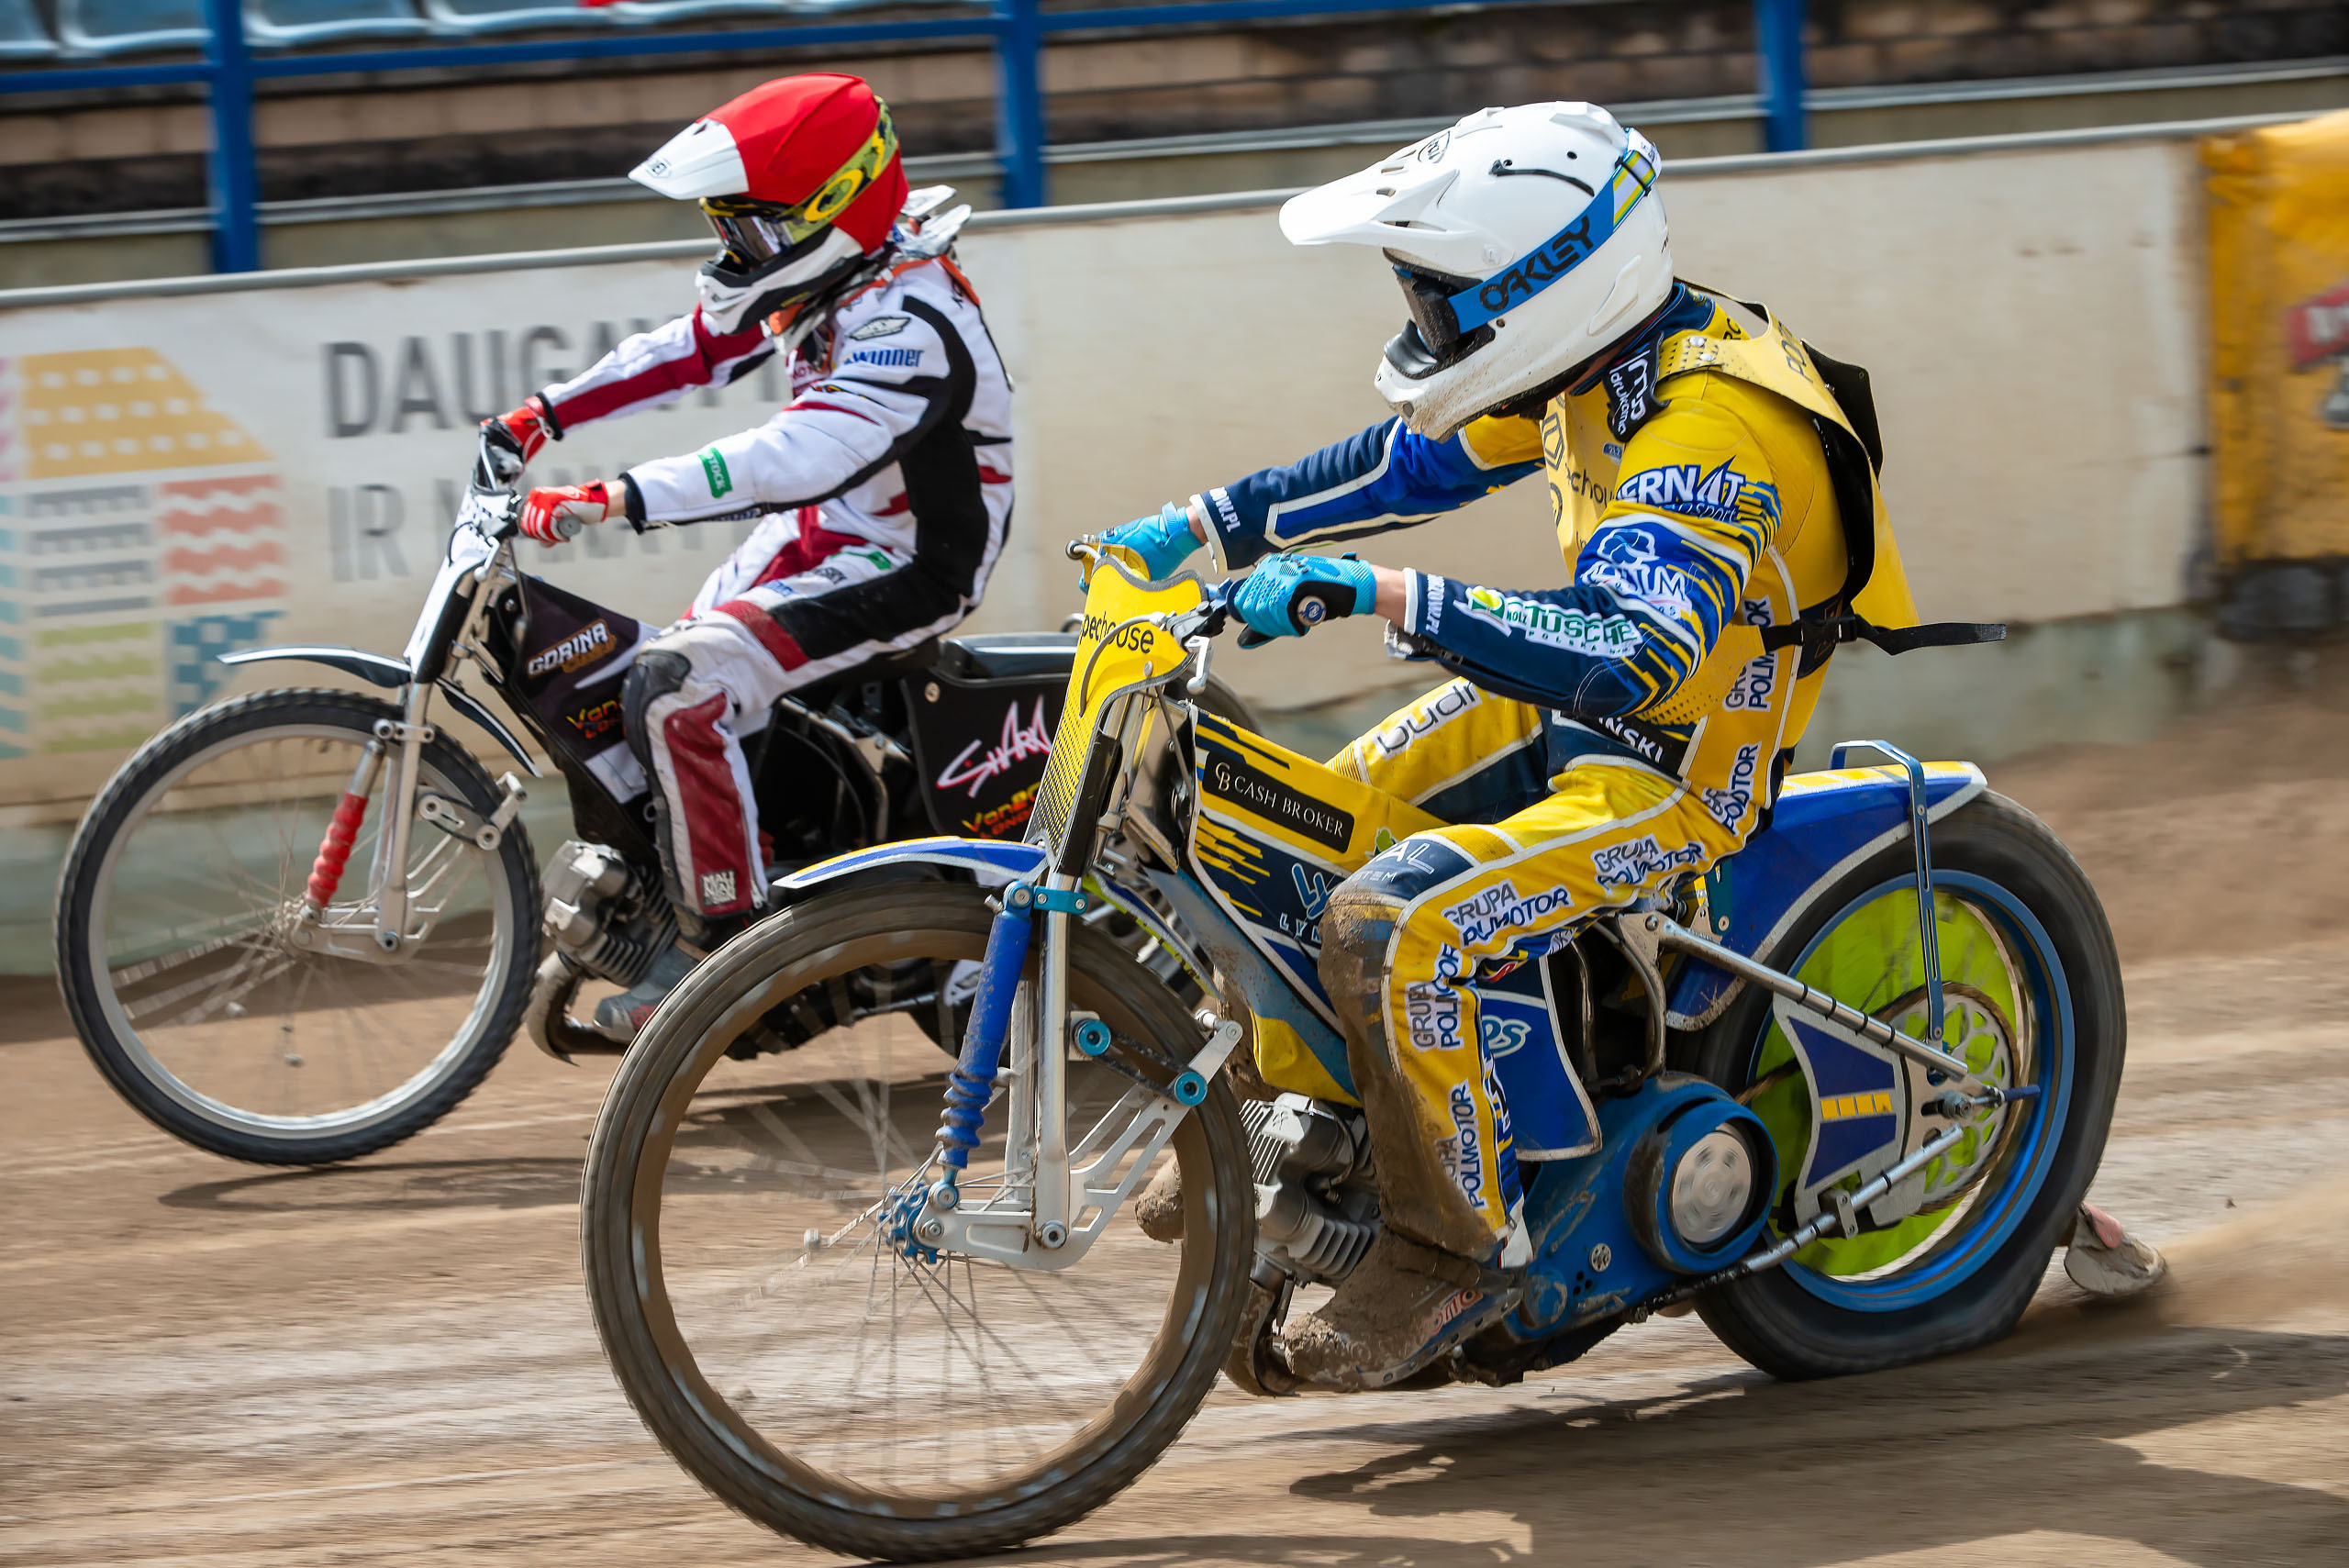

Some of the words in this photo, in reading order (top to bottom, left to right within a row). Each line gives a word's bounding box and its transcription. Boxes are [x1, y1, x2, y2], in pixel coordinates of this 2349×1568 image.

[1479, 215, 1594, 311] OAKLEY
[1618, 465, 1744, 508] ERNAT
[325, 482, 410, 583] IR
[1524, 606, 1641, 645] TUSCHE
[1234, 775, 1277, 809] CASH
[1283, 796, 1343, 839] BROKER
[1453, 1083, 1486, 1209] POLMOTOR
